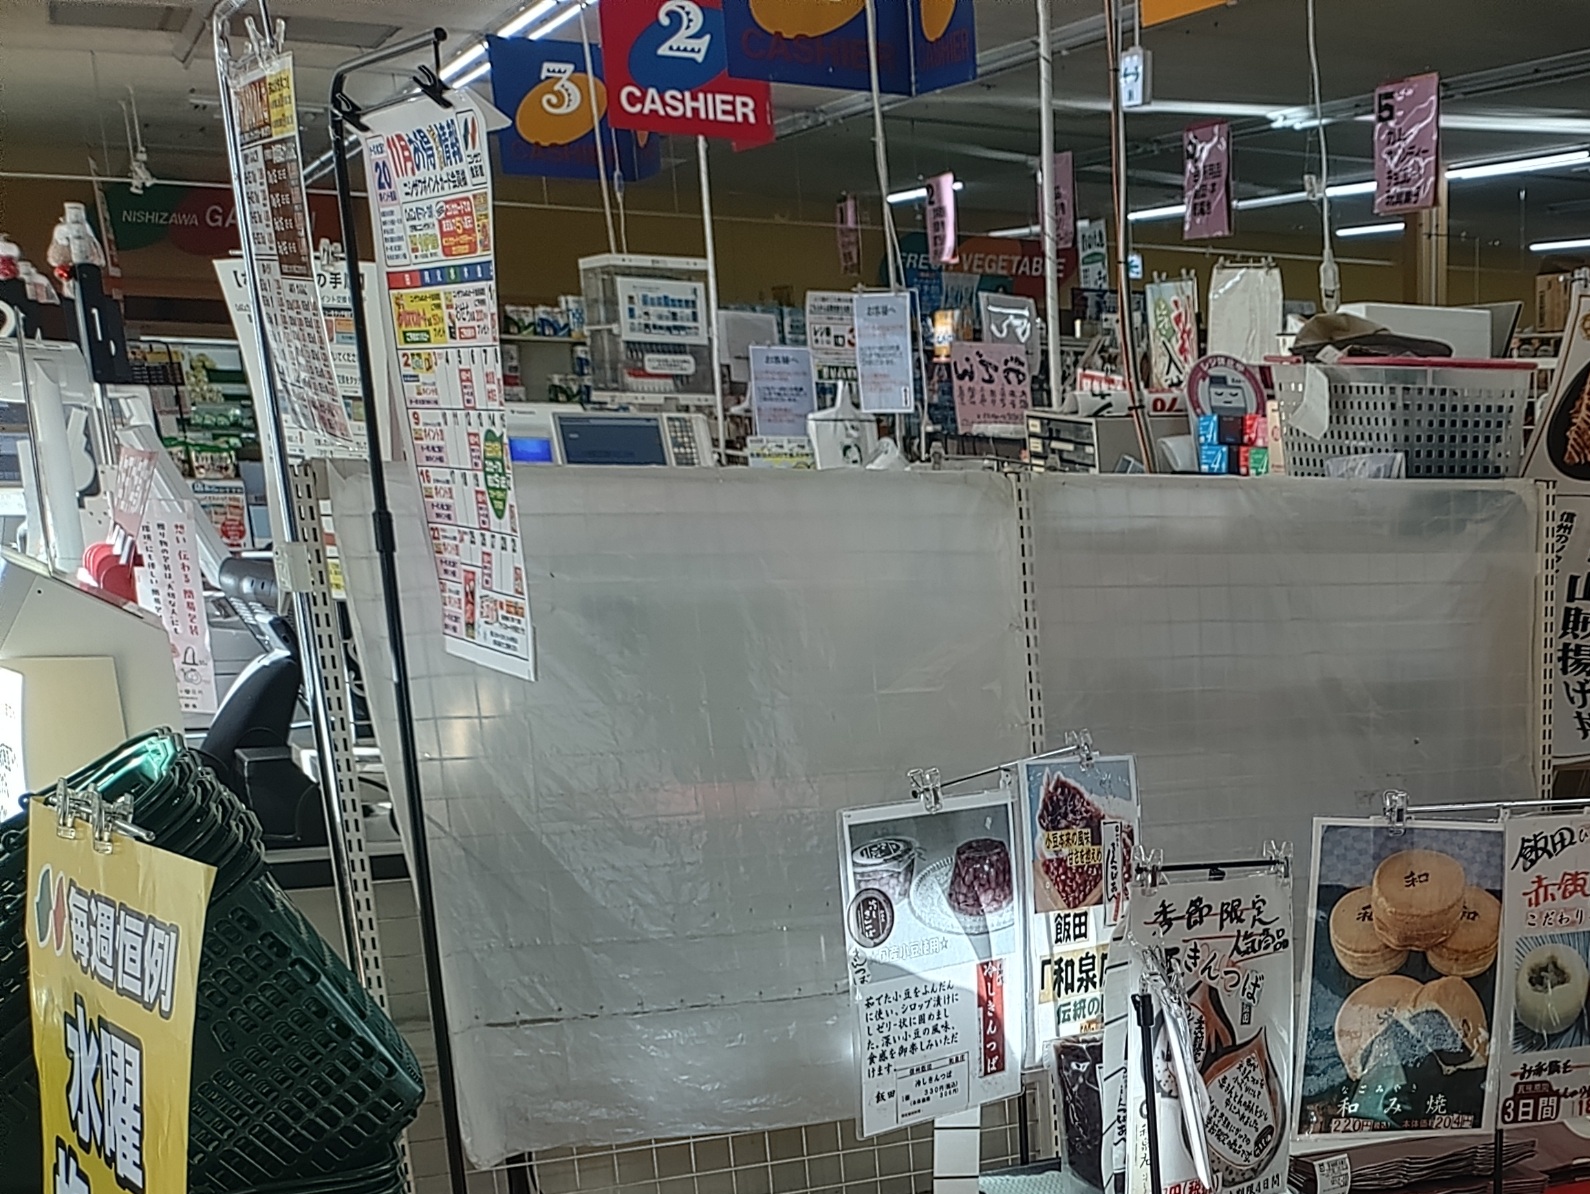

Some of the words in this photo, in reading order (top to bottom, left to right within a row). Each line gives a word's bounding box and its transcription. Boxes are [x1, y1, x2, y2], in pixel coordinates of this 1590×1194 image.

[657, 0, 712, 62] 2
[540, 62, 581, 115] 3
[619, 84, 757, 125] CASHIER
[1378, 91, 1394, 122] 5
[375, 160, 392, 190] 20
[121, 207, 200, 228] NISHIZAWA
[962, 252, 1067, 278] VEGETABE
[1511, 827, 1577, 872] 飯田
[1404, 870, 1430, 888] 和
[1054, 912, 1088, 945] 飯田
[1151, 895, 1280, 936] 季節限定
[1527, 908, 1584, 927] こだわり
[68, 884, 180, 1019] 毎週恒例
[1039, 952, 1108, 999] 「和泉
[983, 960, 1000, 1073] 冷しきんつば
[1056, 994, 1105, 1026] 伝統の
[867, 1062, 898, 1079] けます。
[65, 1001, 146, 1194] 水曜
[1336, 1093, 1448, 1118] 和み焼
[1503, 1097, 1558, 1122] 3日間
